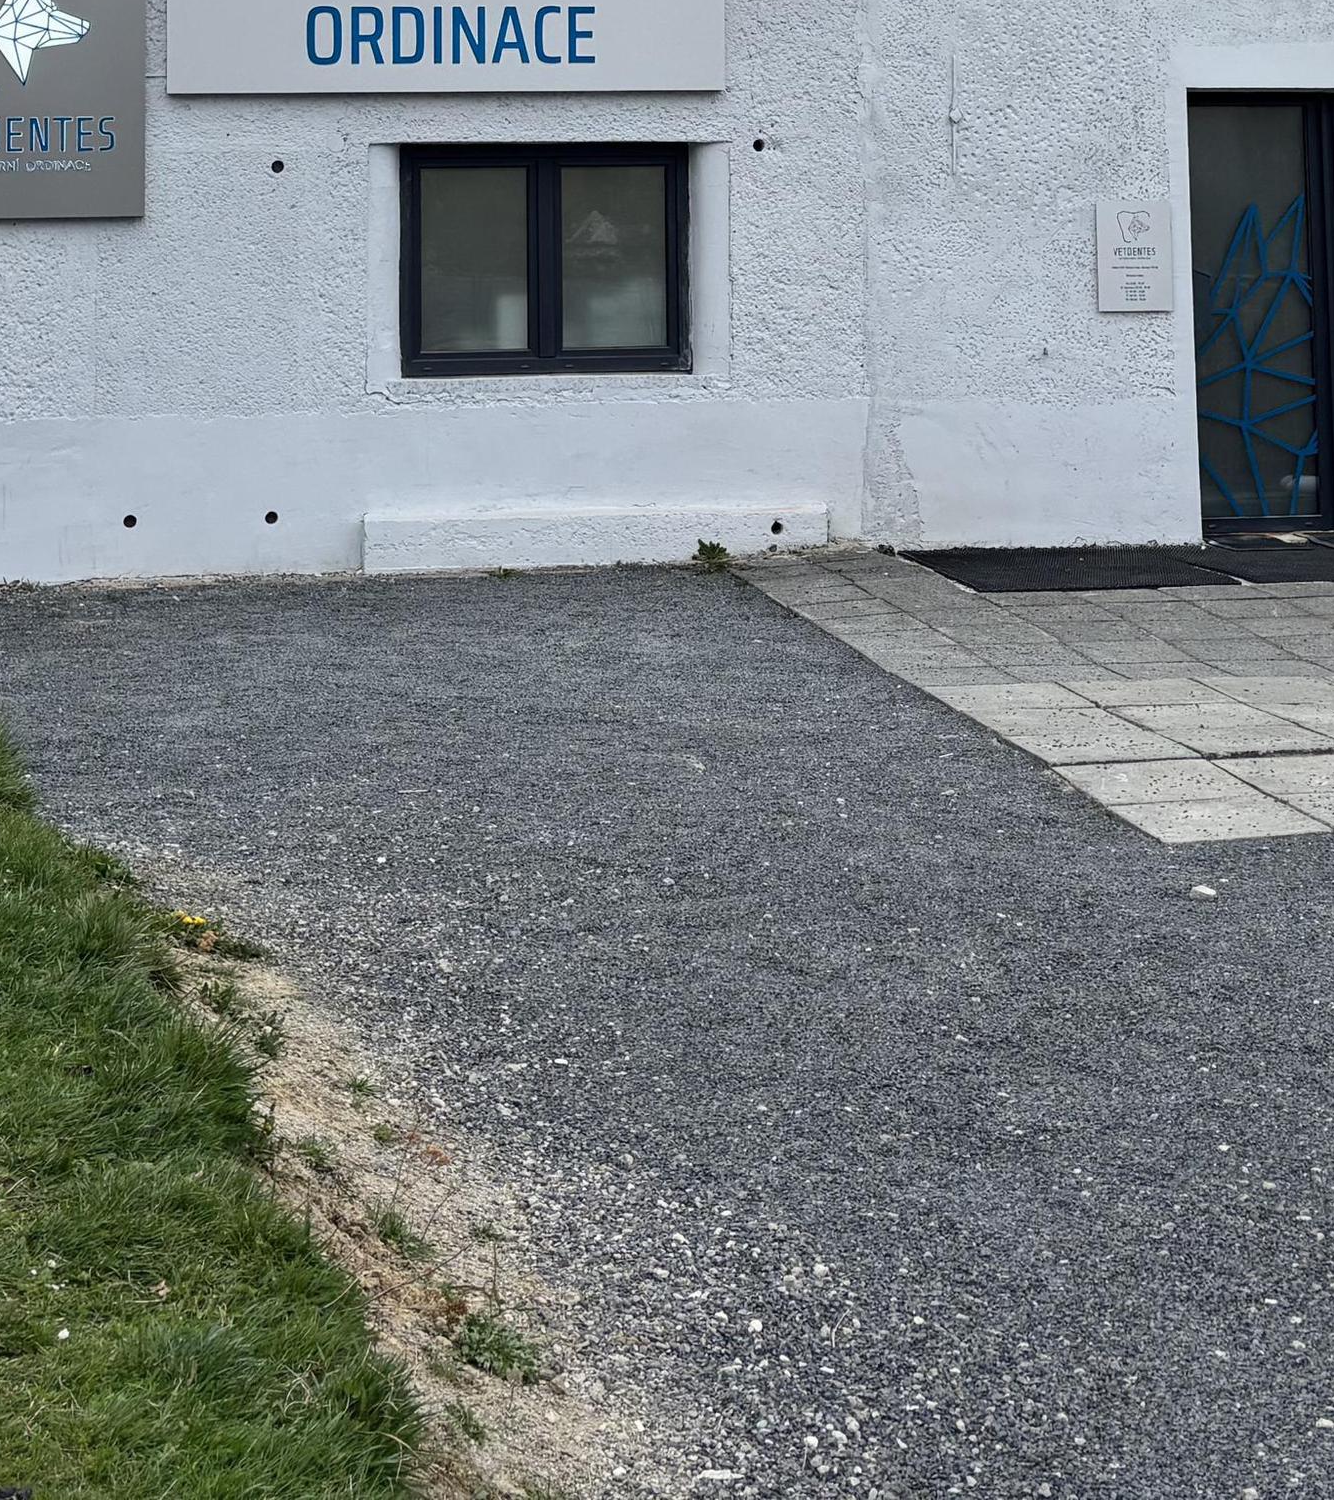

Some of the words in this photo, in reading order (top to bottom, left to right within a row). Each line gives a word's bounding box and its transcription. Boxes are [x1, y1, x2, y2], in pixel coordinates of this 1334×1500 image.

[306, 5, 597, 66] ORDINACE
[25, 159, 92, 172] ORDINACE
[1113, 246, 1156, 256] VETDENTES
